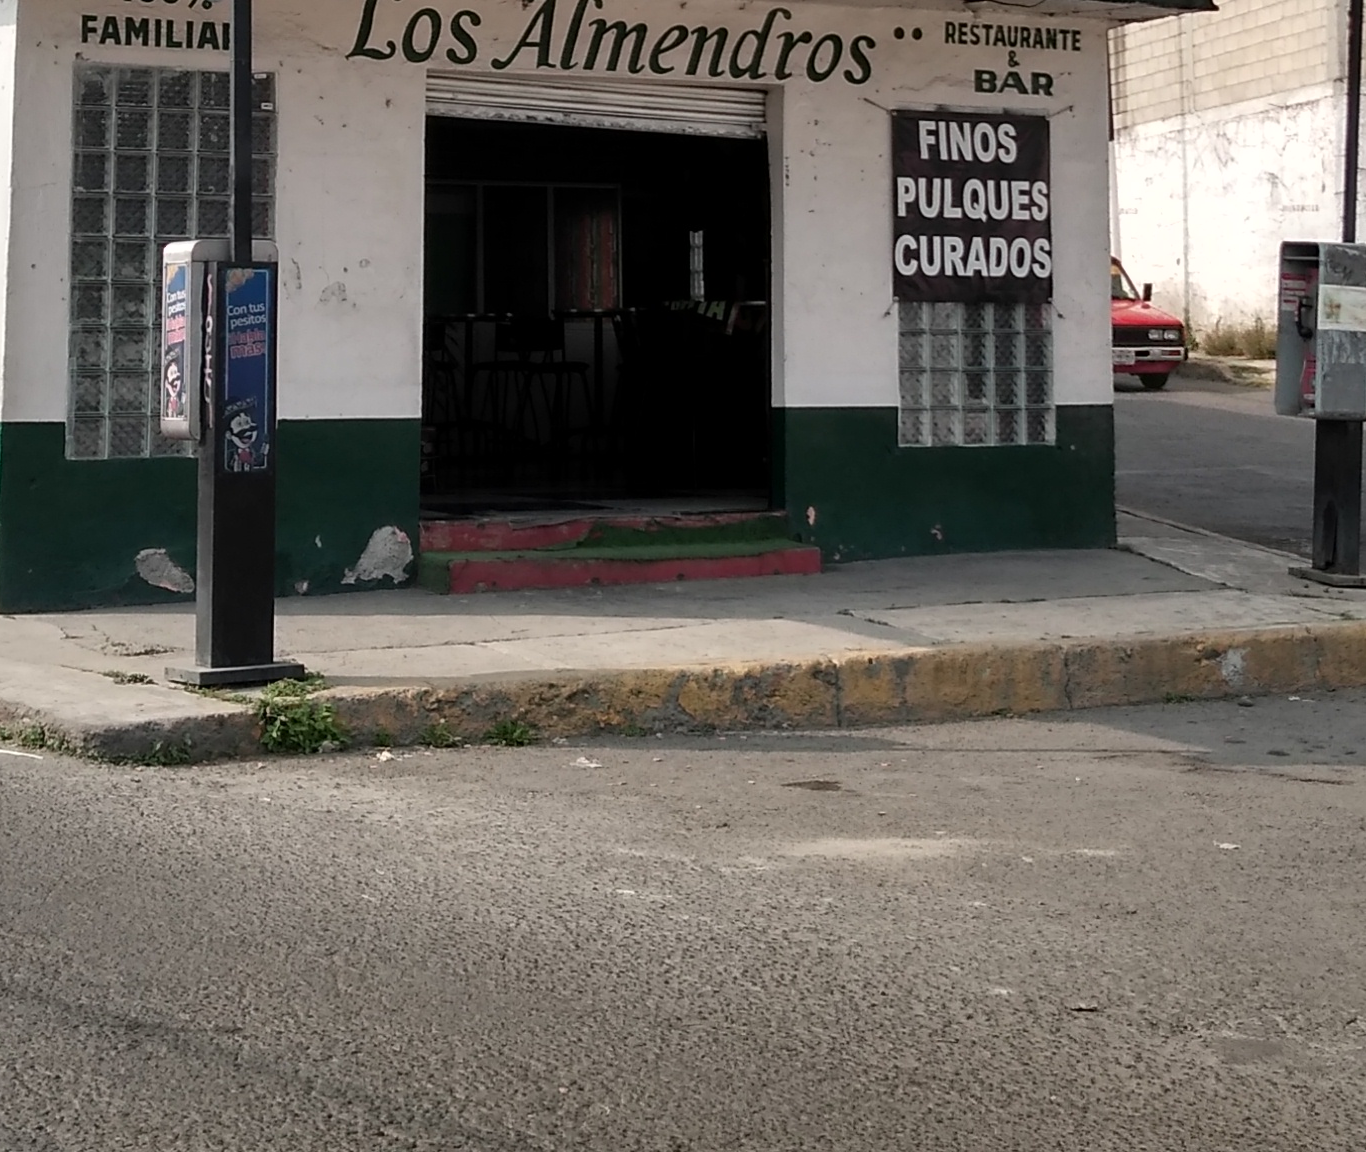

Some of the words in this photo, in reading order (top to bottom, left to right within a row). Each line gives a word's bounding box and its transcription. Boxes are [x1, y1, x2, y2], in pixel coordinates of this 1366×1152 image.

[944, 21, 1081, 51] RESTAURANTE
[1007, 50, 1020, 67] &
[974, 69, 1053, 96] BAR
[918, 120, 1017, 163] FINOS
[896, 176, 1049, 222] PULQUES
[894, 234, 1052, 278] CURADOS
[227, 305, 247, 316] Con
[248, 302, 265, 314] tus
[230, 314, 266, 330] pesitos
